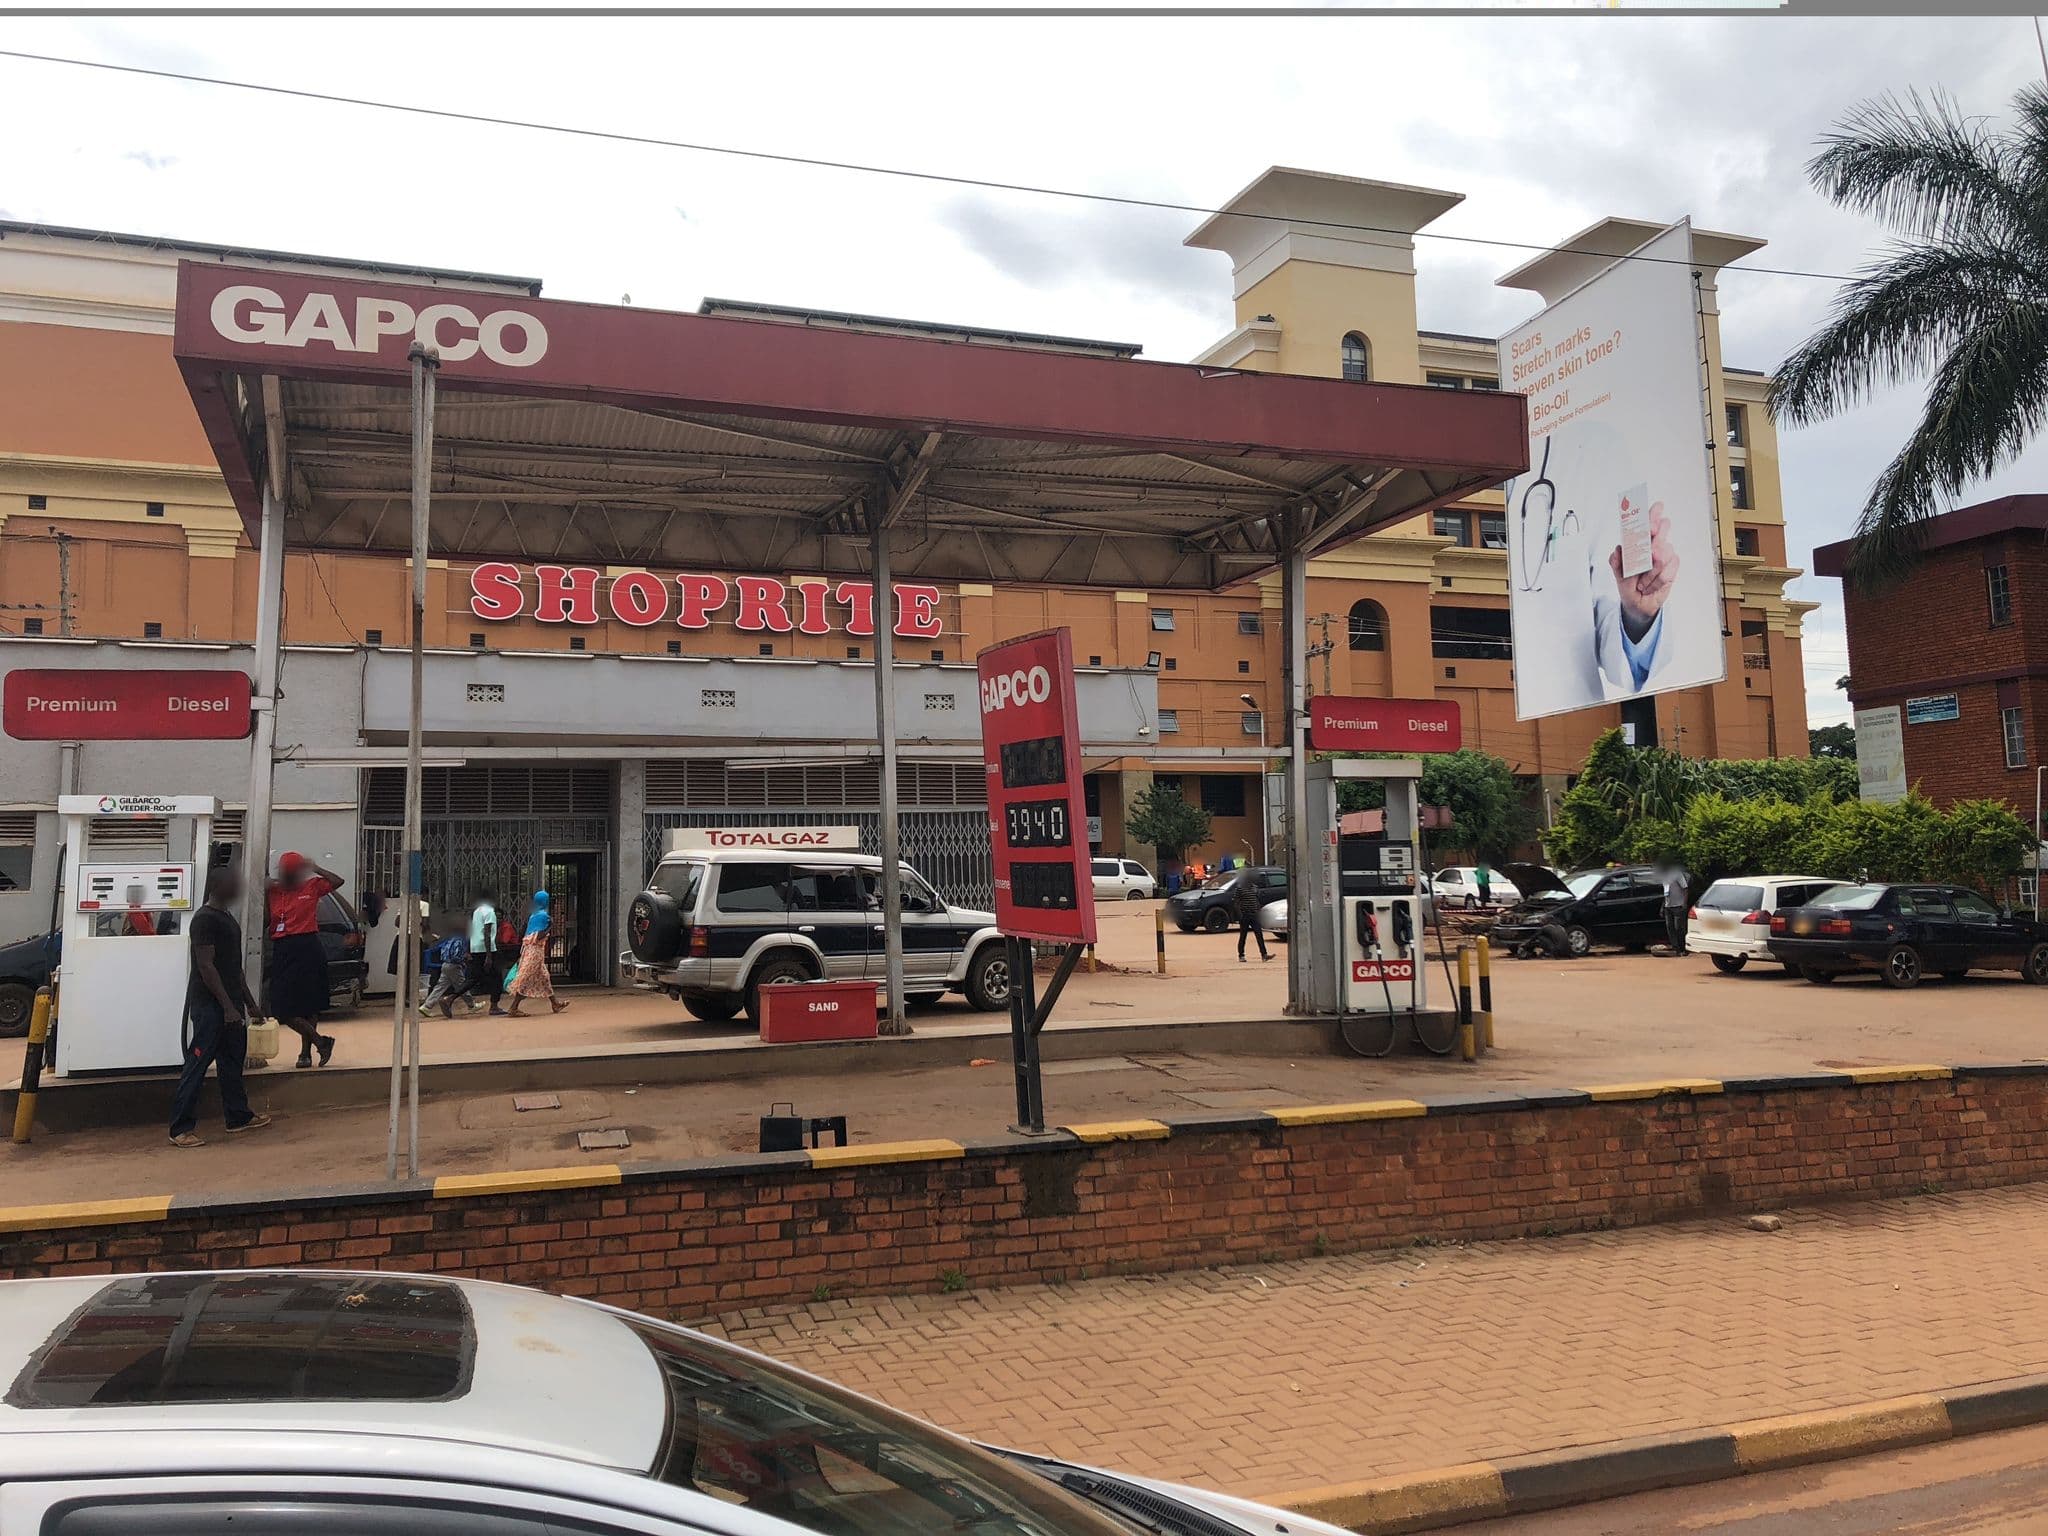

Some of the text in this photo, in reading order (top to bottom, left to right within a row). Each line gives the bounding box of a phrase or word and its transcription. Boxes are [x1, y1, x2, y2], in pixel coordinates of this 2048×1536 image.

[210, 285, 548, 367] GAPCO
[1511, 332, 1542, 360] Scars
[1512, 326, 1591, 382] Stretch marks
[1558, 356, 1583, 381] skin
[1585, 330, 1621, 365] tone?
[1533, 389, 1569, 421] Bio-Oil
[471, 562, 942, 638] SHOPRITE
[27, 696, 230, 712] Premium Diesel
[981, 665, 1051, 714] GAPCO
[1324, 716, 1448, 732] Premium Diesel
[119, 797, 161, 805] GILBARCO
[1009, 806, 1064, 840] 3940
[705, 831, 829, 846] TOTALGAZ
[1356, 964, 1412, 978] GAPCO
[808, 1002, 839, 1012] SAND
